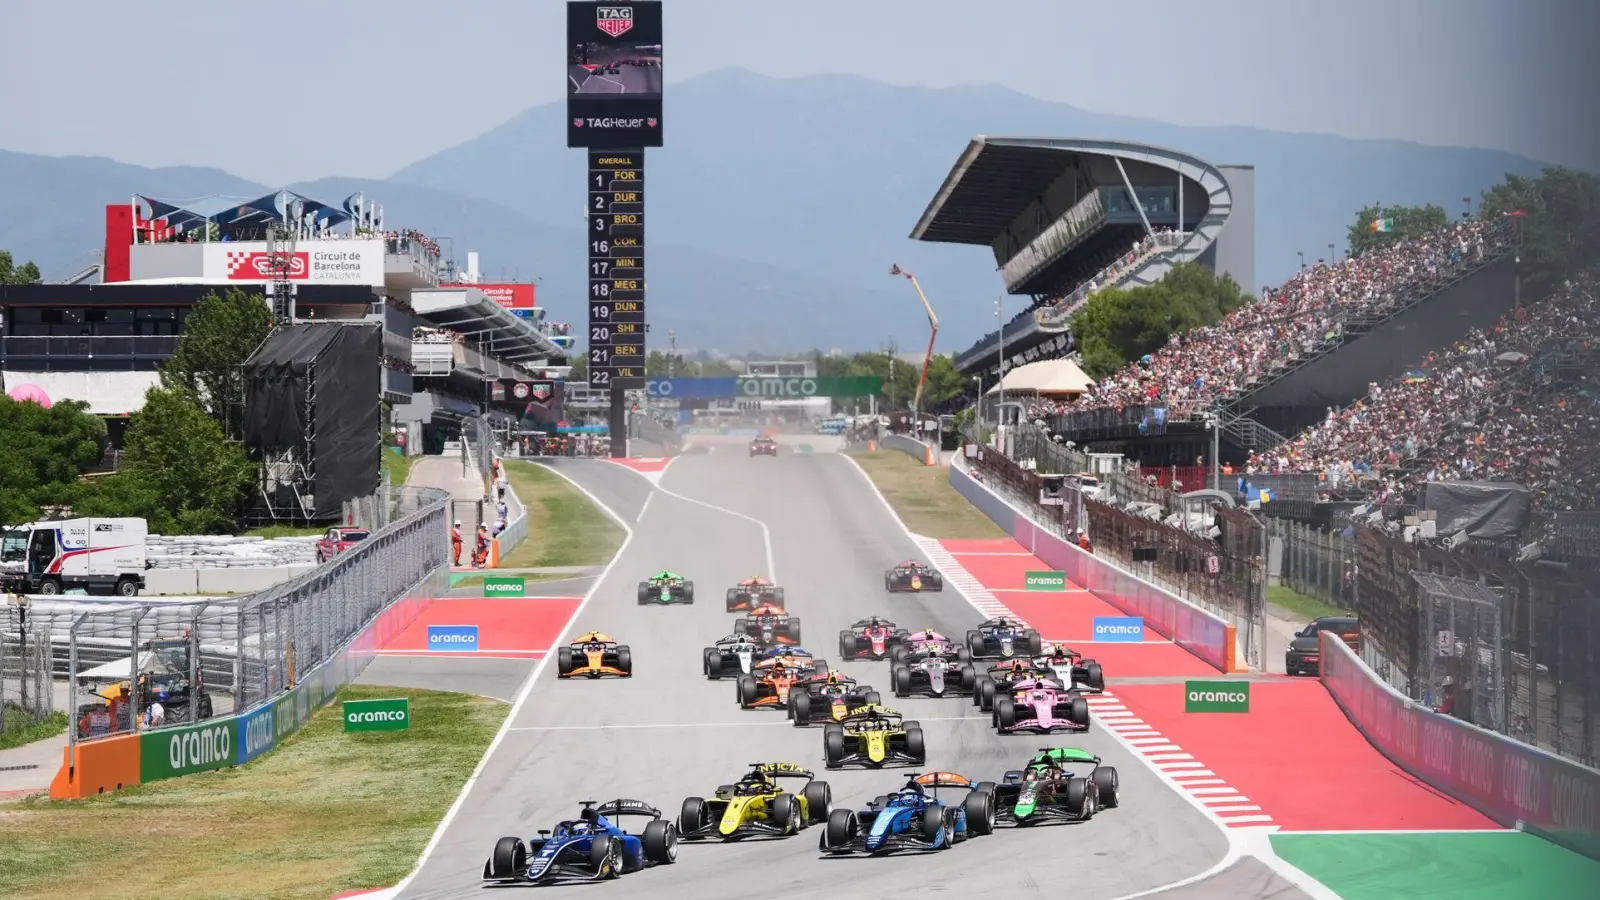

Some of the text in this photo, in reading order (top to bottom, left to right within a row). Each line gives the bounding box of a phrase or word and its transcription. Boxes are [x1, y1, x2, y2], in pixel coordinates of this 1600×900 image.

[600, 9, 630, 18] TAG
[599, 20, 631, 36] HEUER
[598, 157, 632, 165] OVERALL
[595, 171, 636, 187] 1 FOR
[595, 193, 637, 209] 2 DUR
[595, 214, 637, 231] 3 BRO
[592, 240, 609, 253] 16
[314, 252, 361, 261] Circuit de
[314, 262, 361, 271] Barcelona
[592, 258, 635, 275] 17 MIN
[314, 272, 361, 280] CATALUNYA
[592, 280, 637, 297] 18 MEG
[592, 302, 637, 318] 19 DUN
[592, 324, 635, 340] 20 SHI
[592, 346, 636, 362] 21 BEN
[592, 367, 634, 384] 22 VIL
[1027, 577, 1063, 585] aramco
[1096, 624, 1141, 634] aramco
[430, 634, 476, 643] aramco
[1188, 691, 1246, 702] aramco
[348, 710, 405, 723] aramco
[245, 711, 273, 754] aramco
[170, 725, 230, 769] aramco
